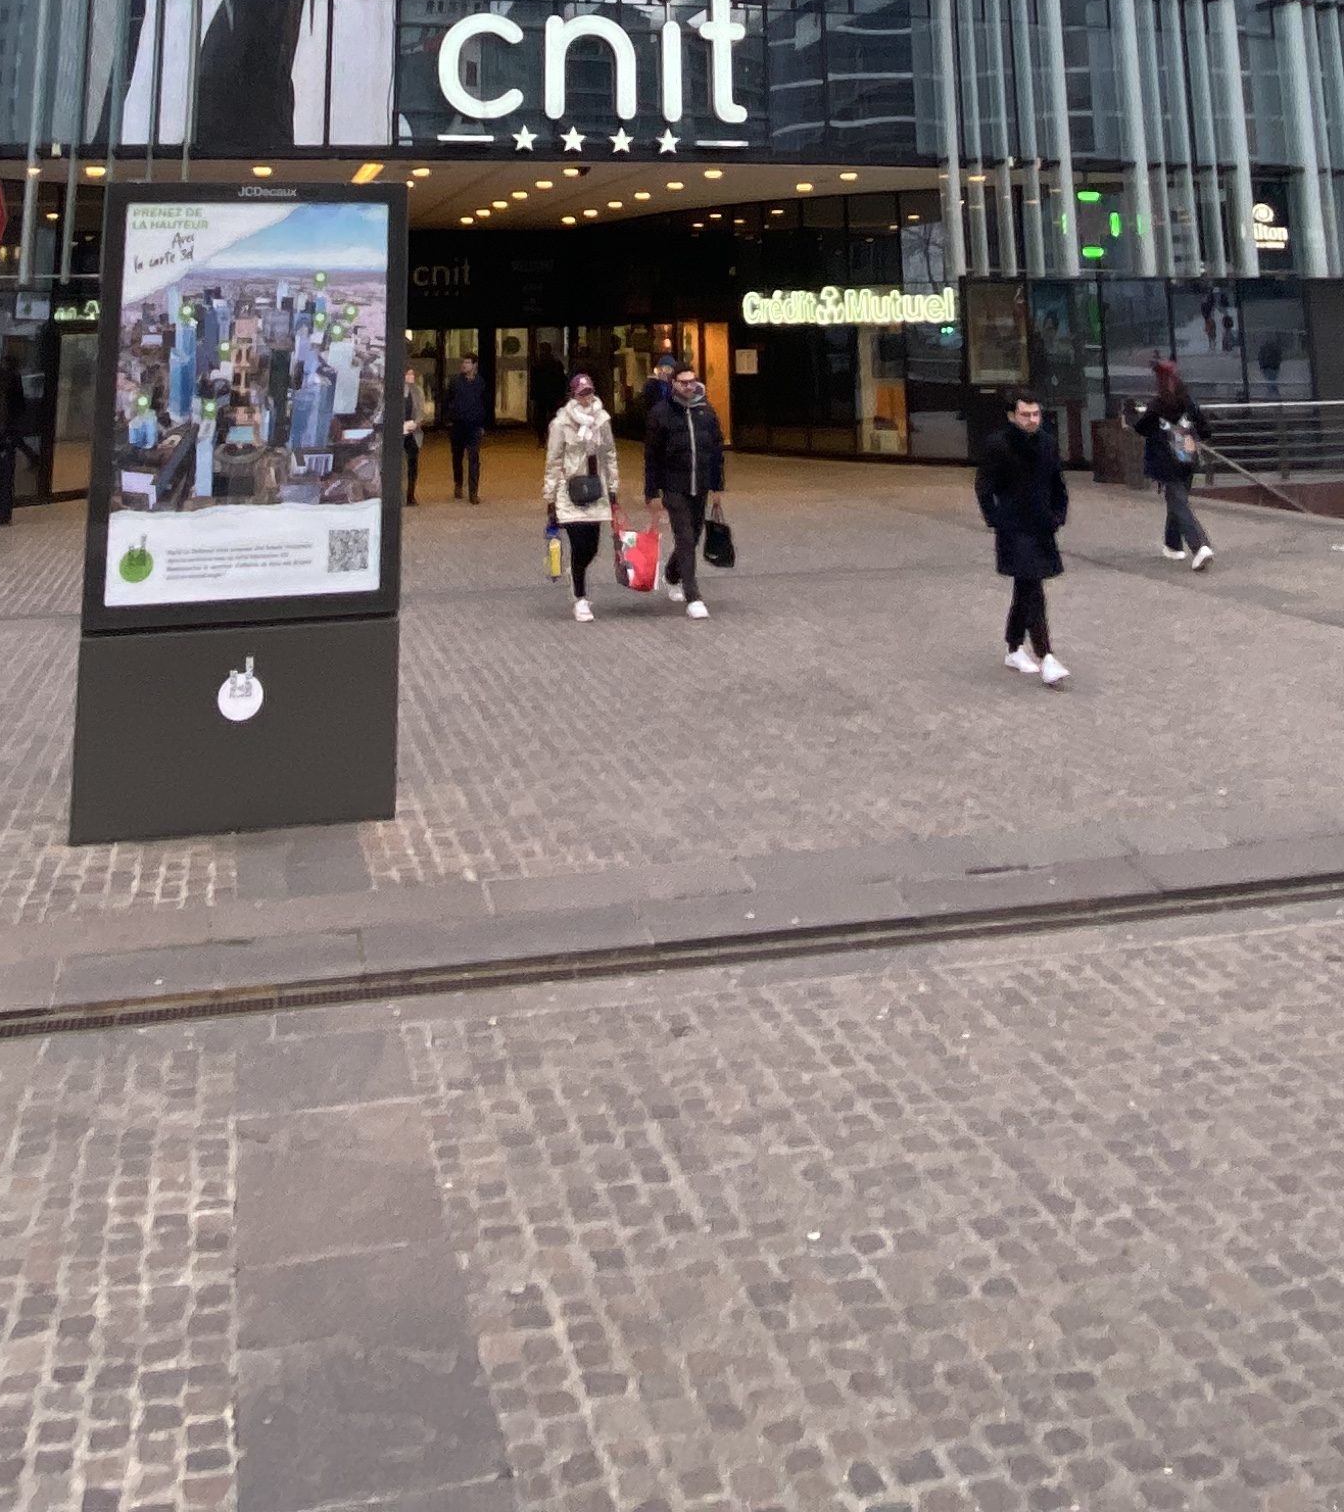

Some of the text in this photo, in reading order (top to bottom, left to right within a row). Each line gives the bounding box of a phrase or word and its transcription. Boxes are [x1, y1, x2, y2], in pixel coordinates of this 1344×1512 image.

[238, 186, 297, 197] JCDecaux
[133, 207, 203, 218] PRENEZ DE
[132, 219, 209, 230] LA HAUTEUR
[1253, 222, 1288, 240] ilton
[413, 257, 471, 286] cnit
[743, 287, 956, 325] Crédit Mutuel
